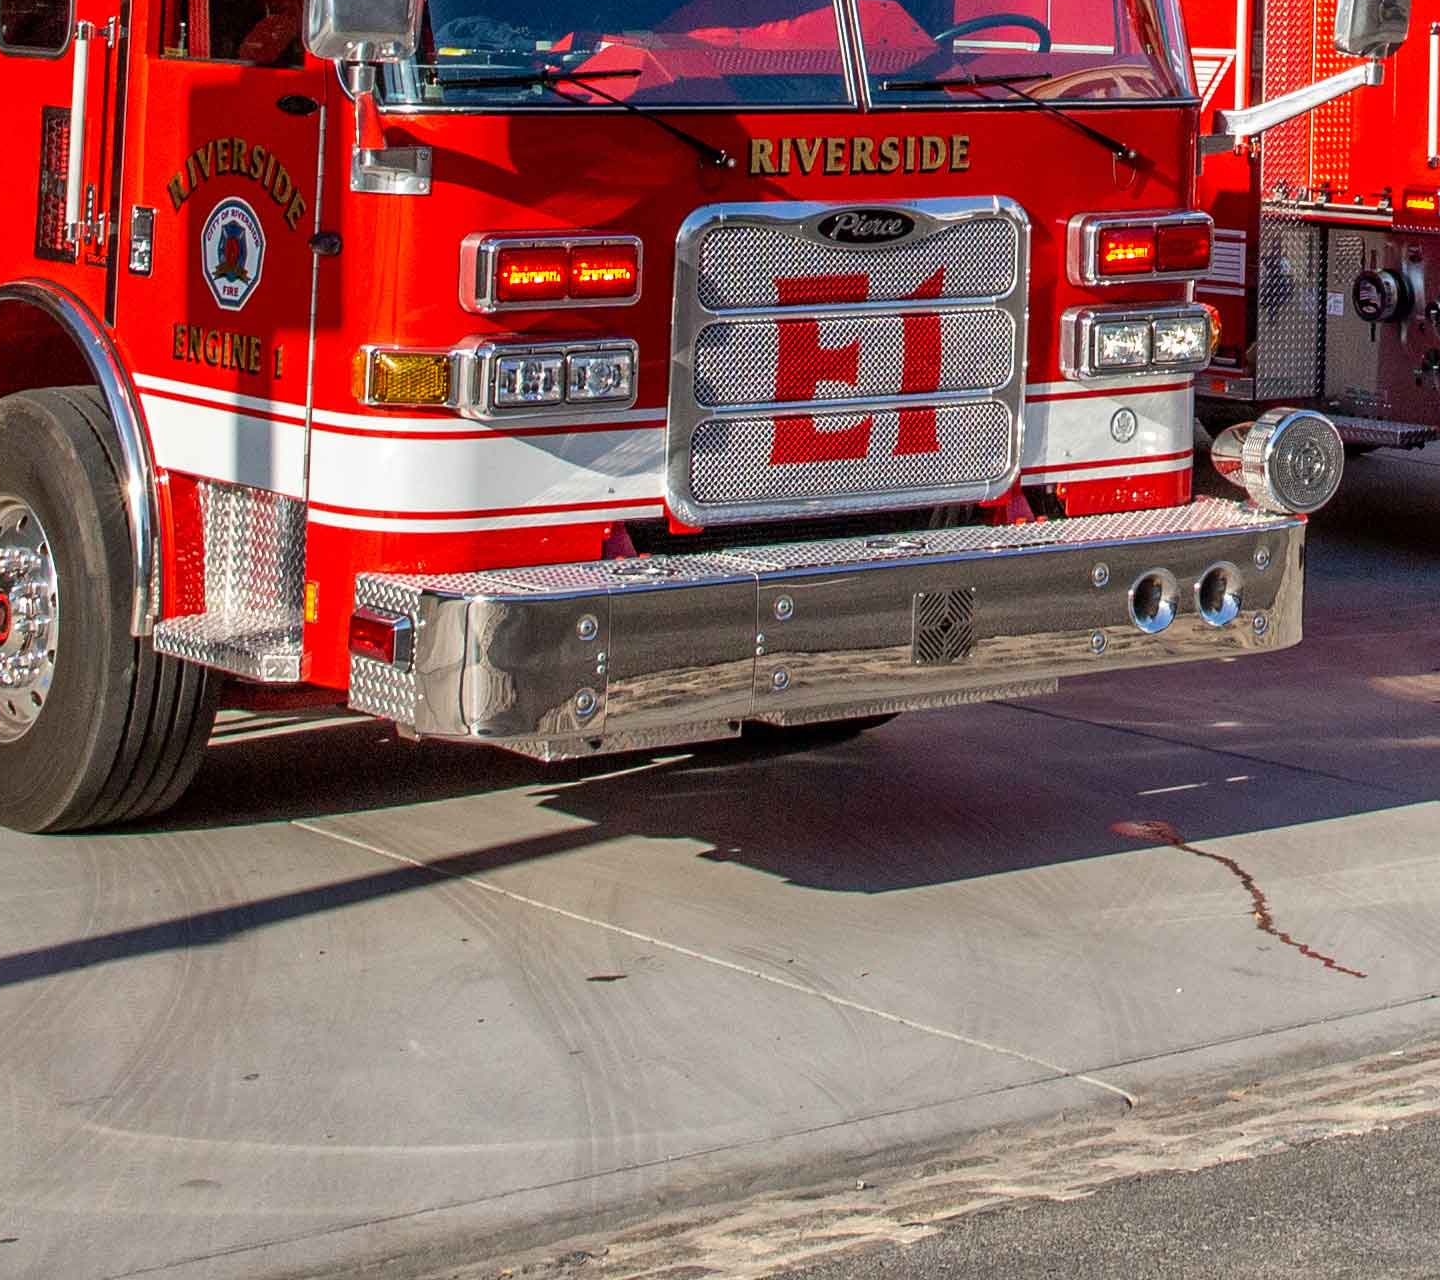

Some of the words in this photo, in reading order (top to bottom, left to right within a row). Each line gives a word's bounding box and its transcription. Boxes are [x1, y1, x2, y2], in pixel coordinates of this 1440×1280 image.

[748, 135, 971, 176] RIVERSIDE
[168, 137, 307, 231] RIVERSIDE
[206, 218, 221, 241] CITY
[220, 209, 230, 221] OF
[231, 208, 261, 247] RIVERSIDE
[829, 211, 904, 240] Pierce
[222, 285, 240, 297] FIRE
[172, 322, 262, 374] ENGINE
[273, 343, 285, 380] 1
[767, 265, 946, 466] E1
